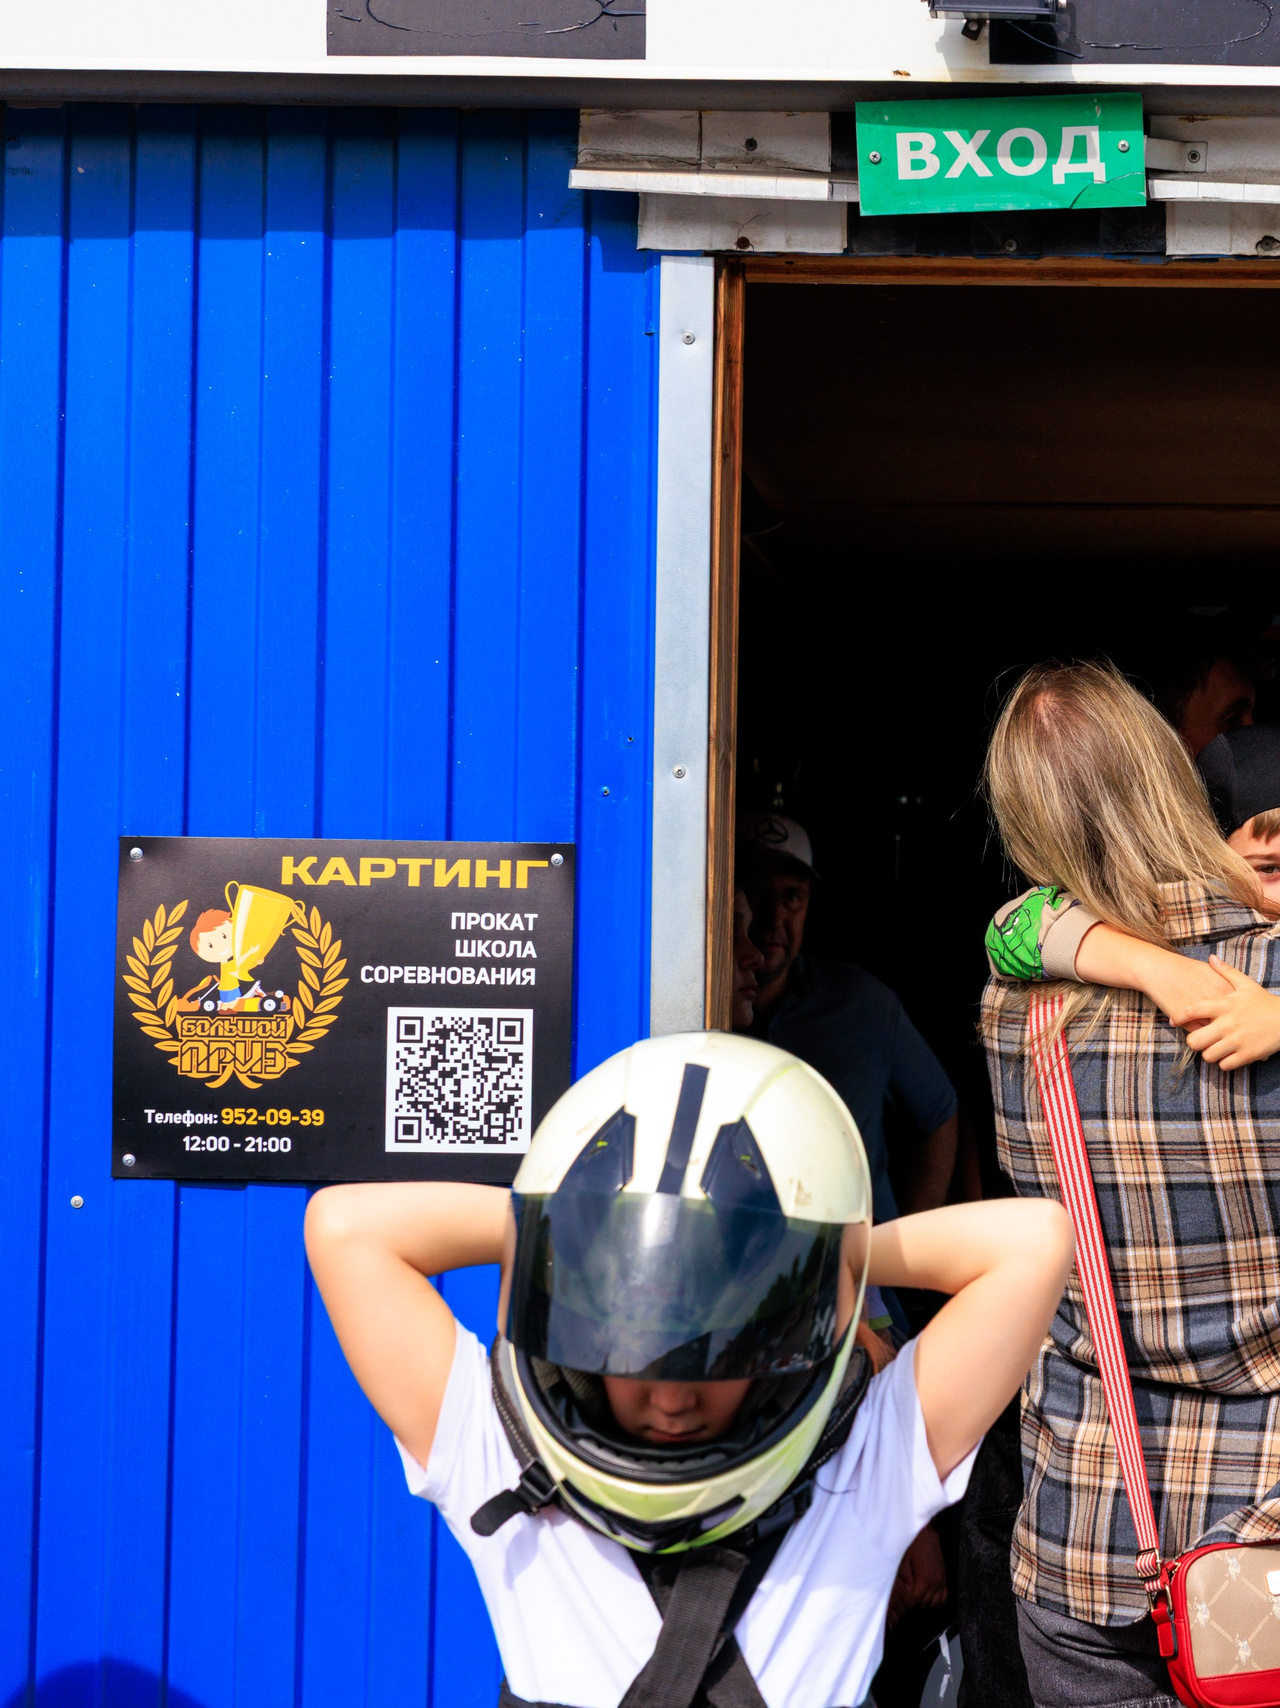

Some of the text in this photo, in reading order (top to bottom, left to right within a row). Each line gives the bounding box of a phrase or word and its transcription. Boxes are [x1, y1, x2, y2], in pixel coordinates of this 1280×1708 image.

[896, 125, 1106, 185] ВХОД
[281, 856, 549, 889] КАРТИНГ
[451, 912, 538, 931] ПРОКАТ
[455, 940, 537, 959] ШКОЛА
[360, 965, 536, 986] СОРЕВНОВАНИЯ
[181, 1017, 287, 1038] БОЛЬШОЙ
[180, 1040, 287, 1074] ПРИЗ
[144, 1108, 324, 1126] Телефон: 952-09-39
[183, 1136, 229, 1152] 12:00
[245, 1137, 292, 1153] 21:00
